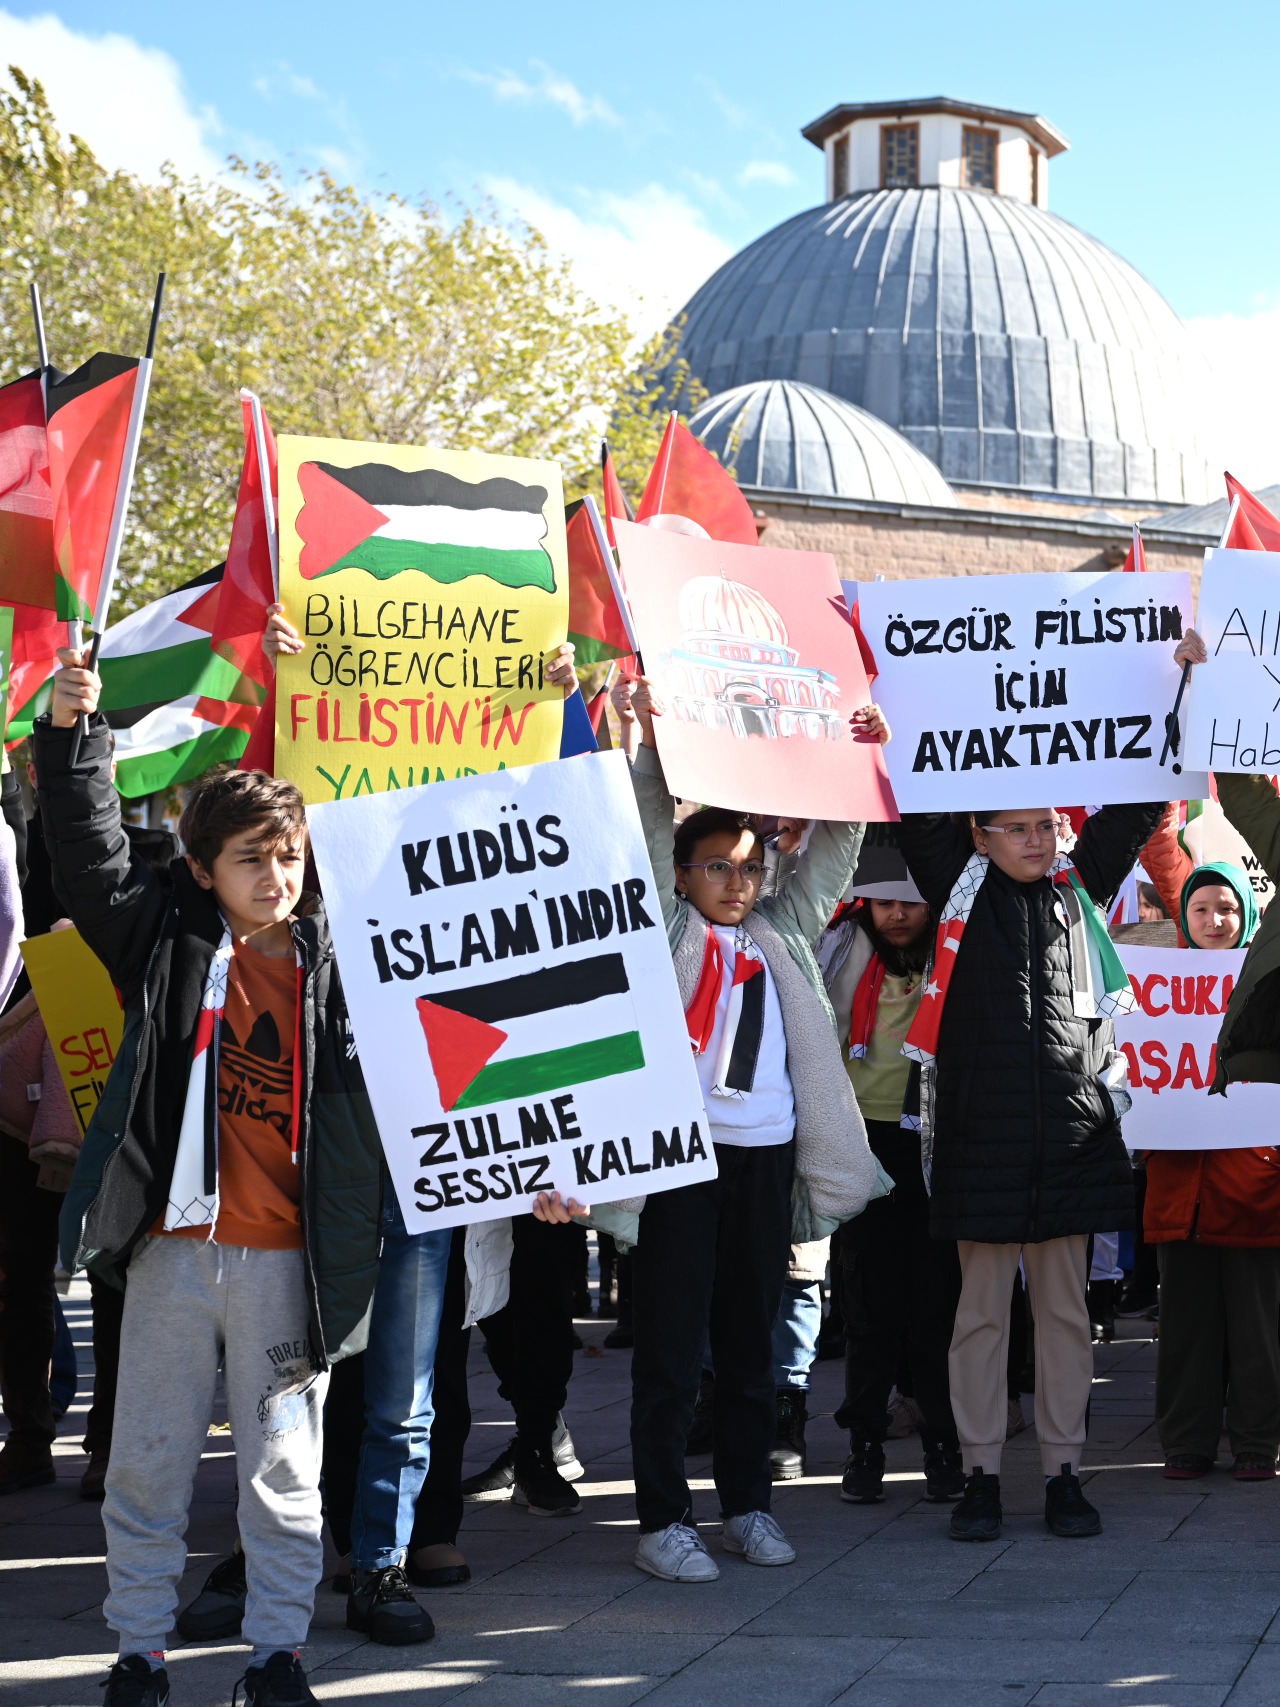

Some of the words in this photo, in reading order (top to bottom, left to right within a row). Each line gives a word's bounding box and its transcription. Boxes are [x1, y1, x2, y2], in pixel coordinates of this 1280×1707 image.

[305, 593, 523, 644] BİLGEHANE
[885, 607, 1016, 657] ÖZGÜR
[1034, 598, 1184, 650] FİLİSTİN
[310, 643, 545, 690] ÖĞRENCİLERİ
[994, 660, 1068, 713] İÇİN
[290, 691, 537, 750] FİLİSTİN'İN
[401, 803, 569, 896] KUDÜS
[410, 1093, 582, 1167] ZULME
[413, 1154, 555, 1212] SESSİZ
[572, 1121, 708, 1185] KALMA
